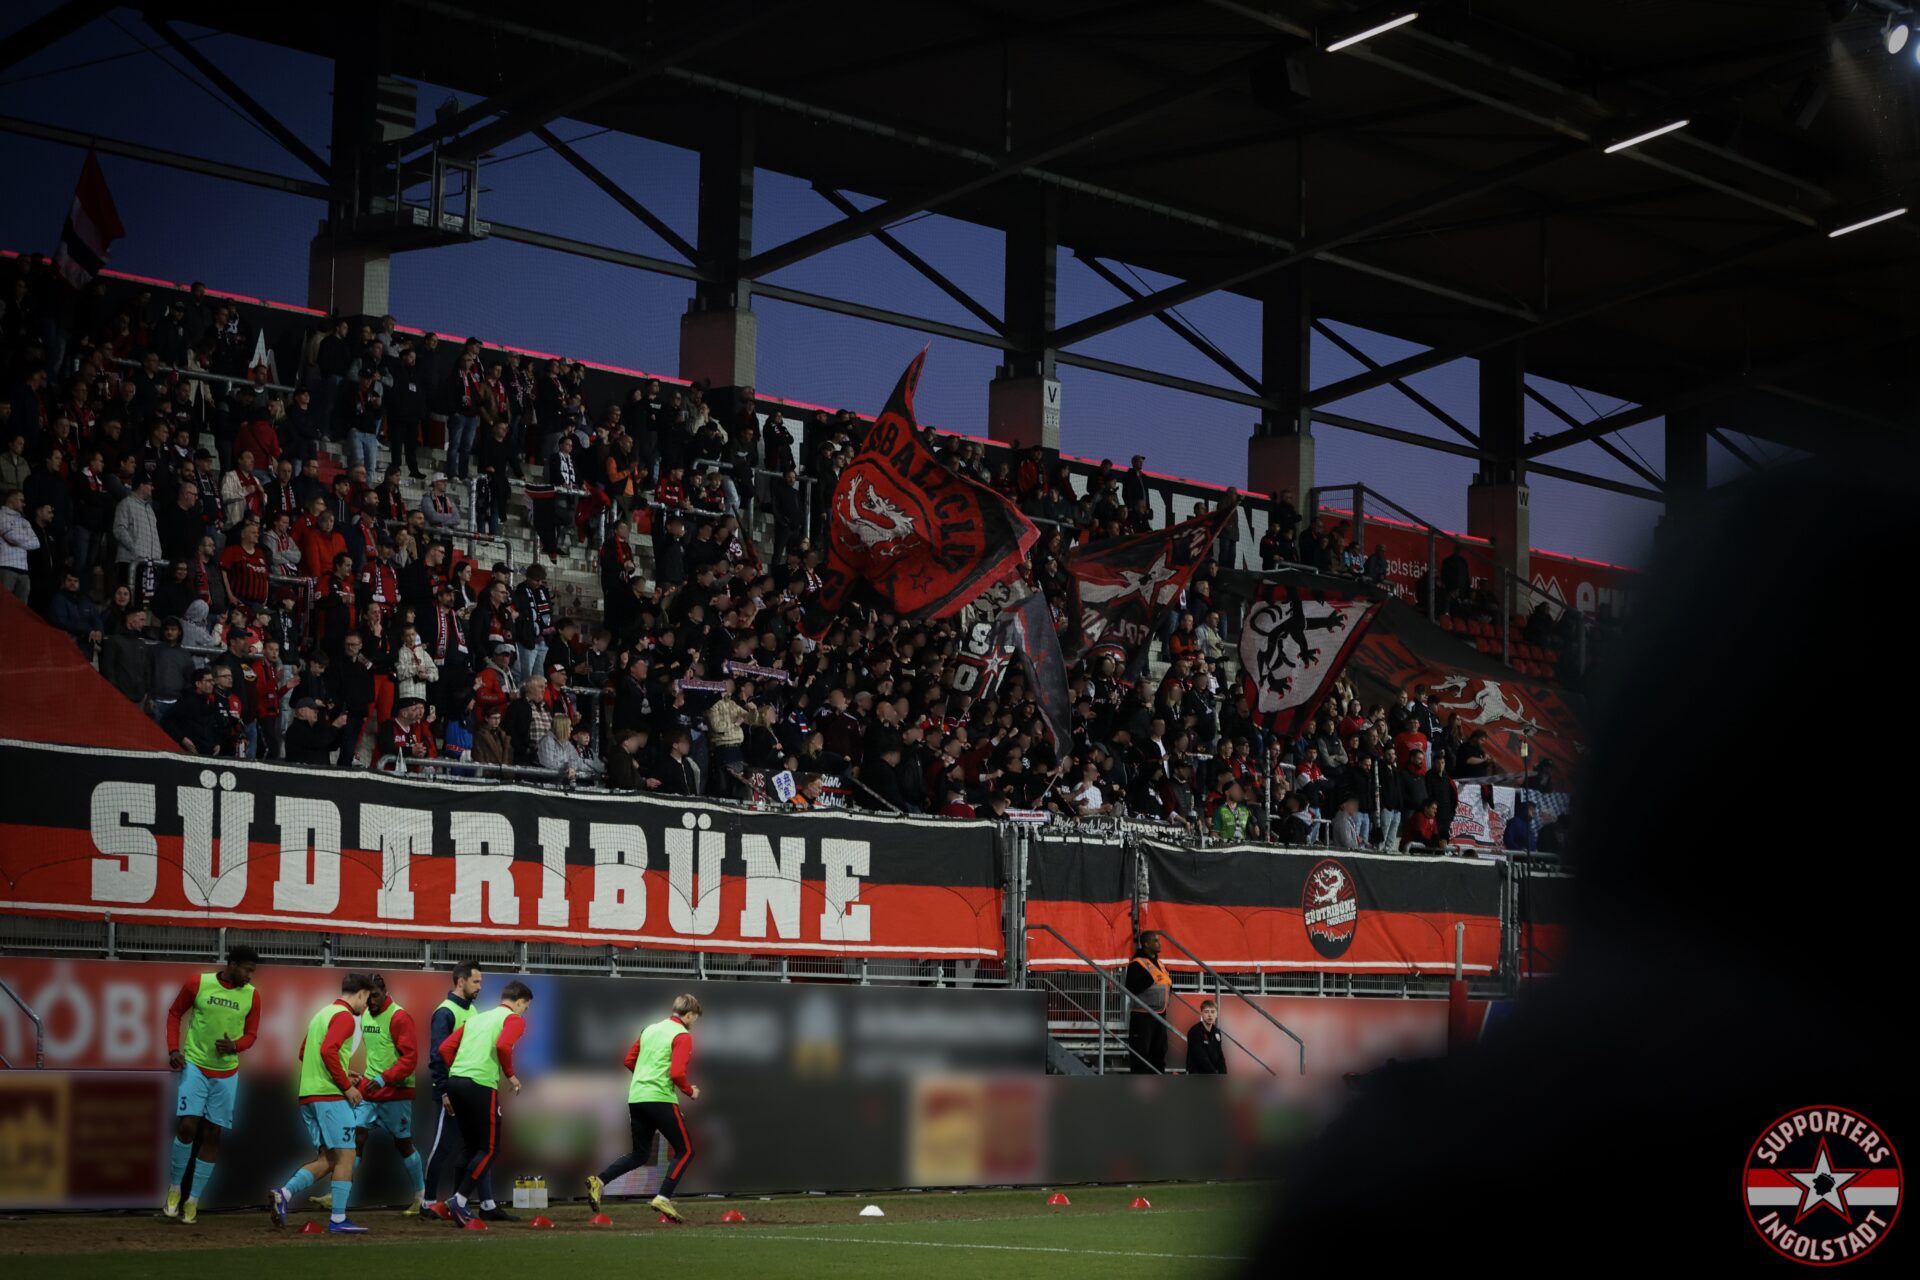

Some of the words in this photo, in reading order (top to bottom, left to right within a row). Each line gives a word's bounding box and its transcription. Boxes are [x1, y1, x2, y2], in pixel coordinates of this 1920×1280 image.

[1048, 385, 1057, 404] V
[1519, 488, 1529, 507] W
[90, 769, 871, 941] SÜDTRIBÜNE
[363, 1025, 381, 1034] oma
[179, 1096, 187, 1111] 3
